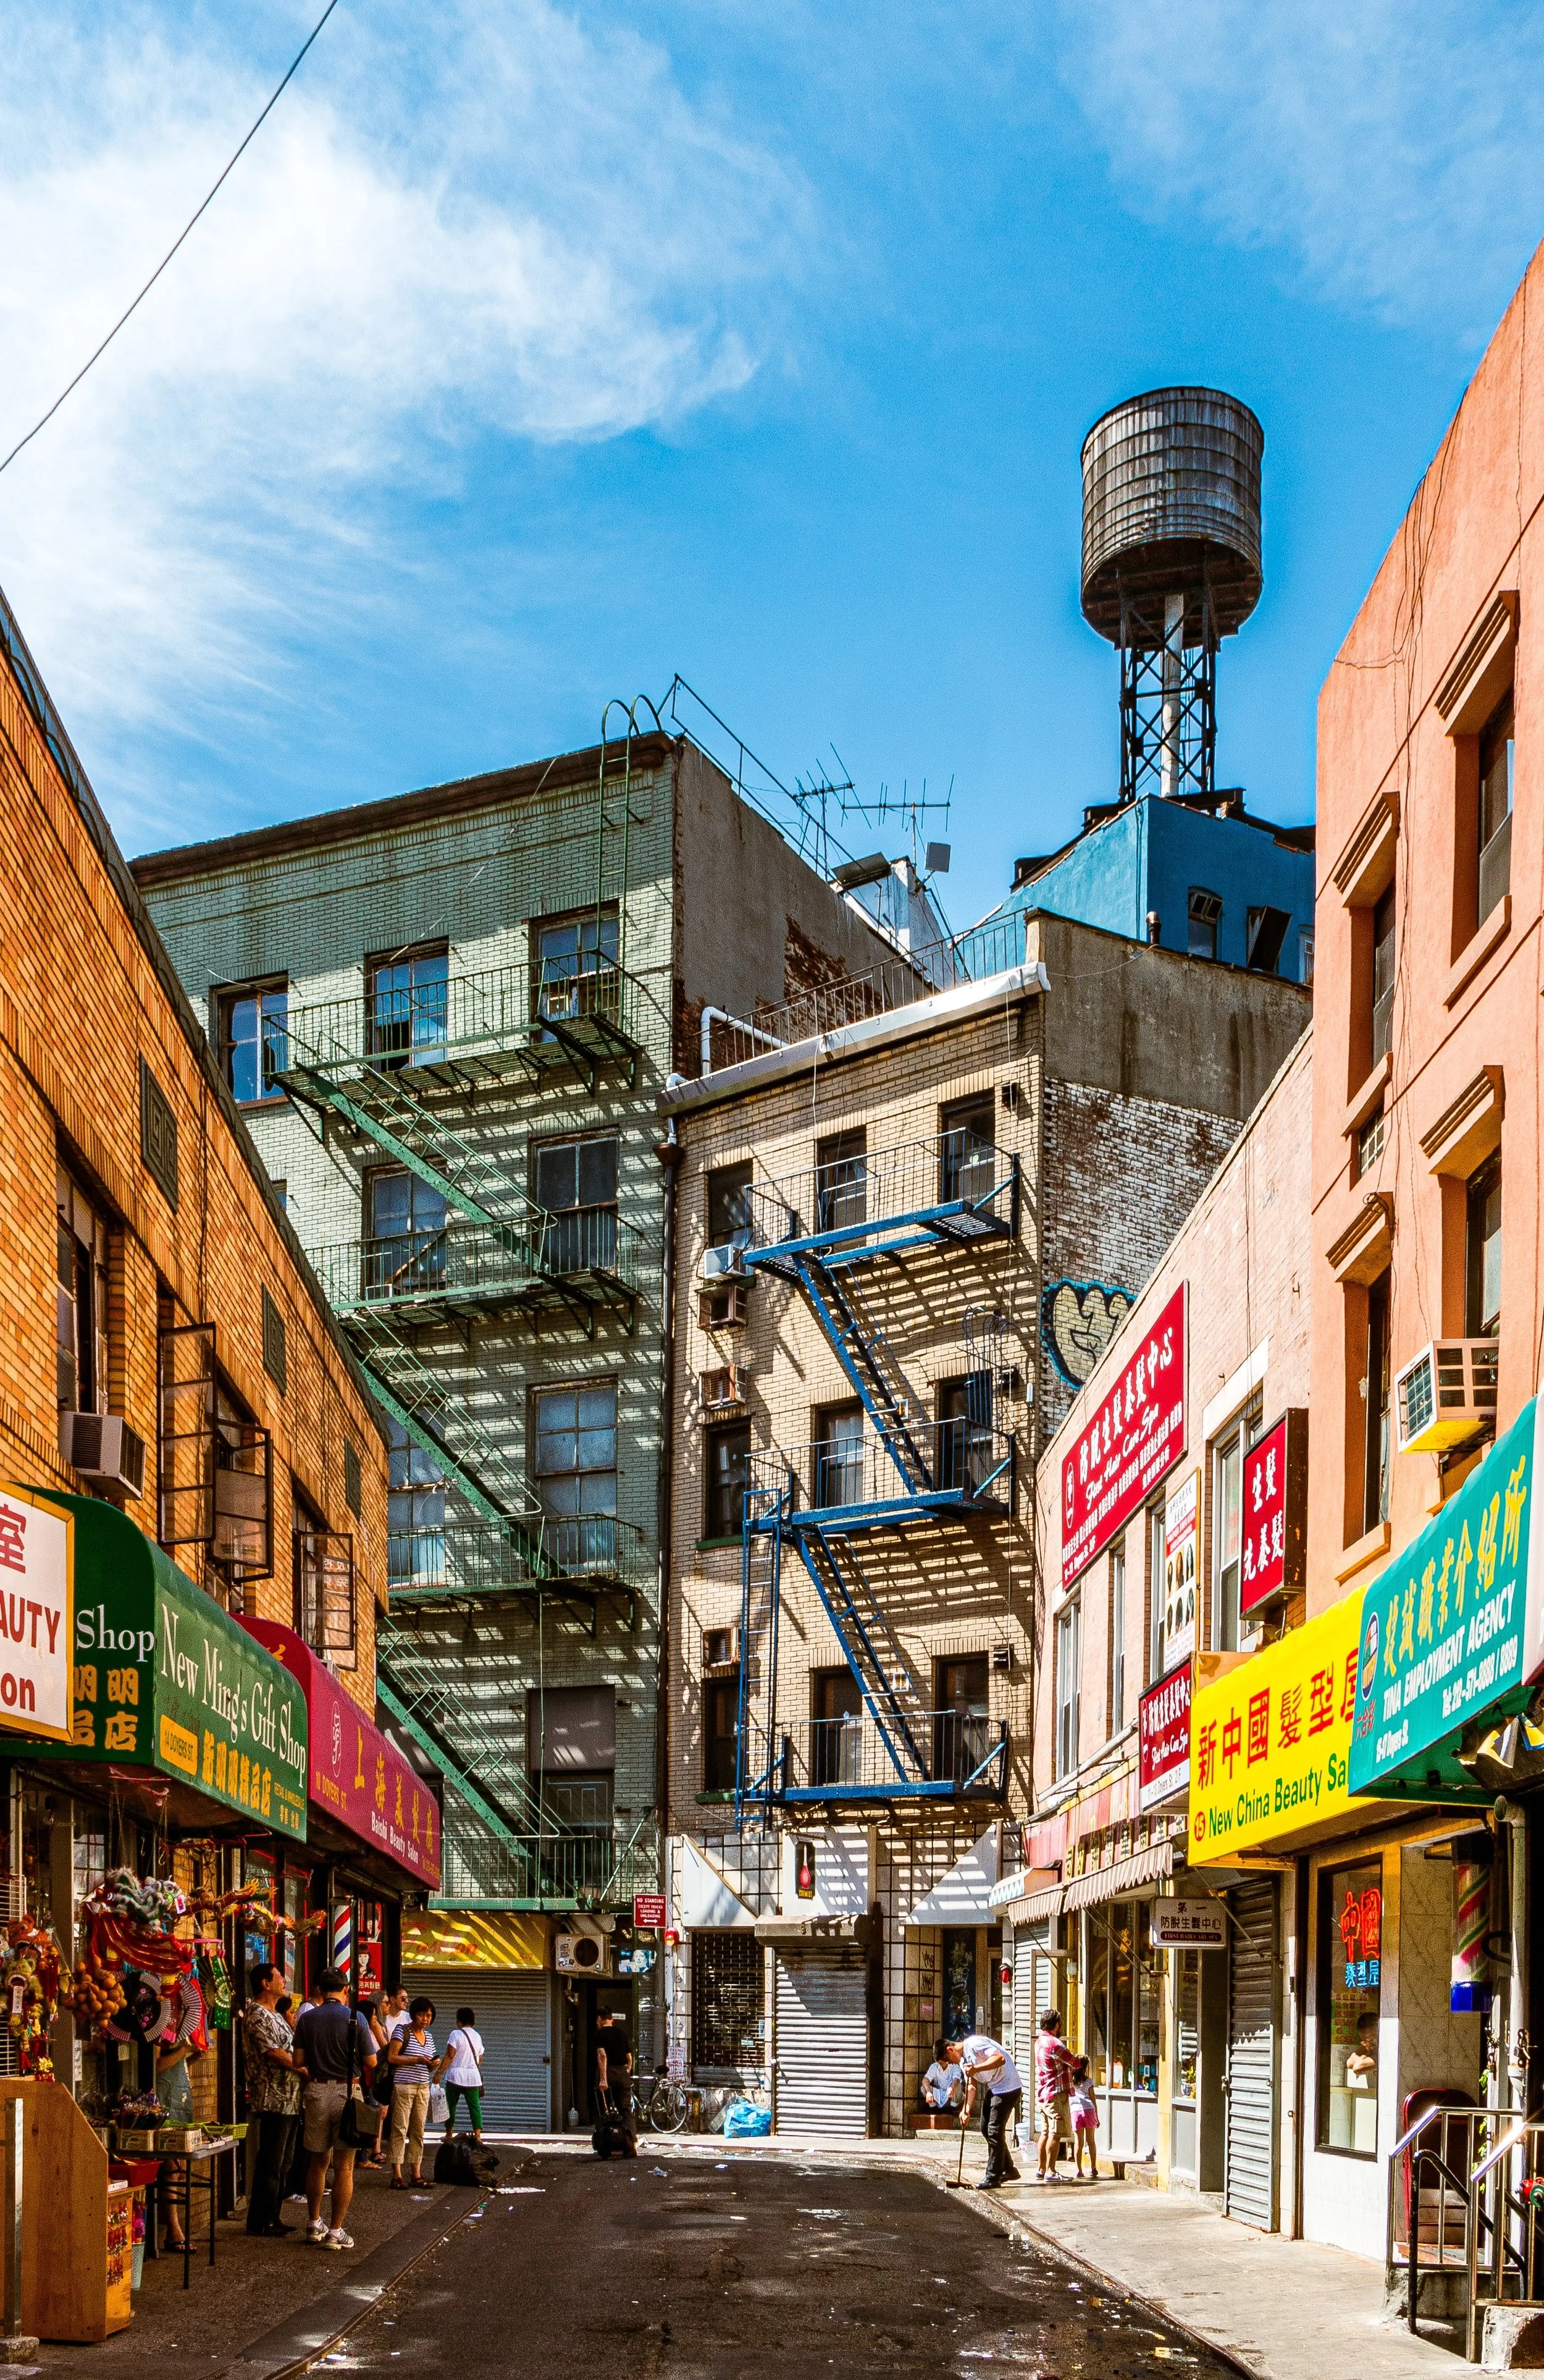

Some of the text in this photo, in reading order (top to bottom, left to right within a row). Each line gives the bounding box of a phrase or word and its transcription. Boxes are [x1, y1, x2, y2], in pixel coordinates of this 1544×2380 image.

[1104, 1453, 1121, 1482] Hair
[1122, 1428, 1139, 1457] Care
[1139, 1403, 1159, 1441] Spa
[1383, 1455, 1527, 1677] 職業介紹所
[76, 1604, 154, 1662] Shop
[1383, 1680, 1401, 1722] TINA
[1403, 1625, 1465, 1707] EMPLOYMENT
[1466, 1579, 1516, 1657] AGENCY
[0, 1672, 35, 1712] on
[161, 1604, 306, 1789] New Ming's Gift Shop
[1178, 1727, 1188, 1754] Spa
[372, 1810, 387, 1840] Baishi
[390, 1825, 405, 1857] Beauty
[1209, 1806, 1233, 1838] New
[1237, 1789, 1270, 1827] China
[1274, 1765, 1323, 1813] Beauty
[1177, 1901, 1207, 1914] 第一
